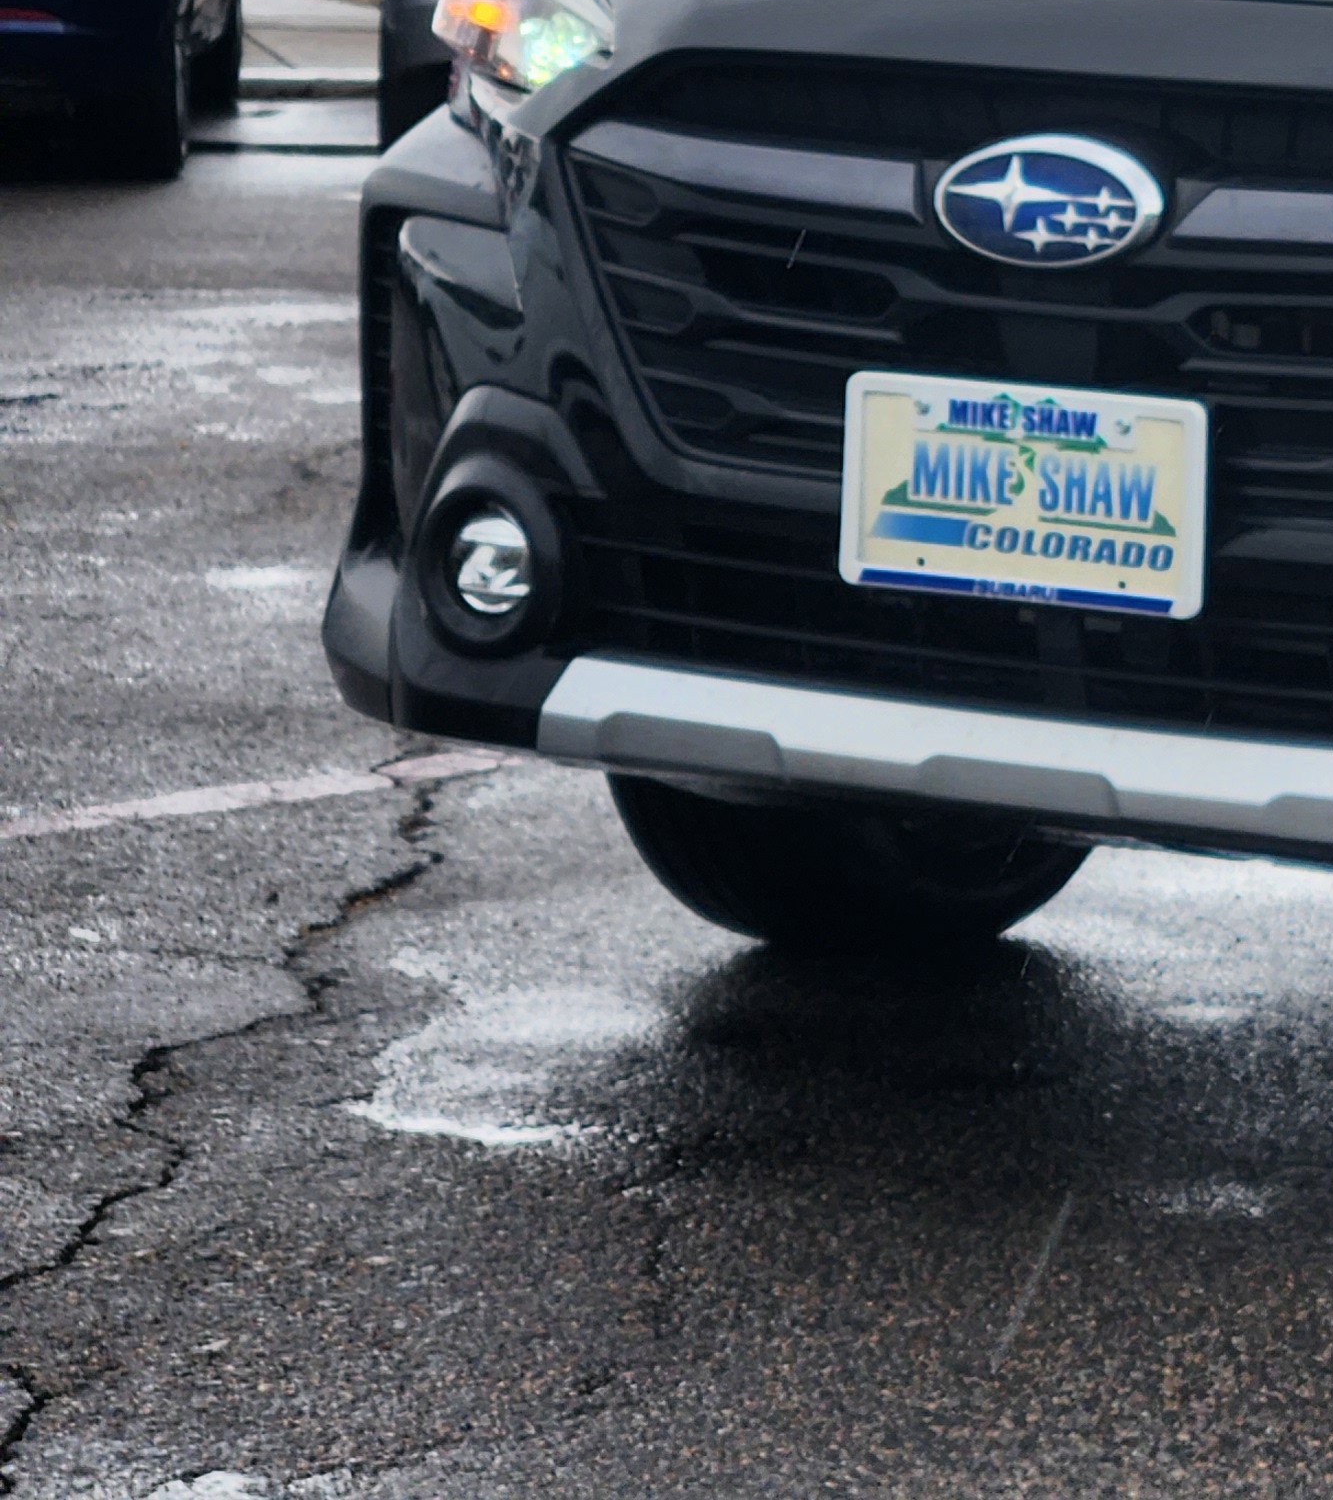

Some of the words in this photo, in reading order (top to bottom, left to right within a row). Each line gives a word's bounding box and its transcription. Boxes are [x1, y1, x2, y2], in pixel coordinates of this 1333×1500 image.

[948, 398, 1012, 431] MIKE
[1022, 406, 1097, 439] SHAW
[912, 441, 1015, 505] MIKE
[1037, 454, 1155, 523] SHAW
[966, 522, 1174, 572] COLORADO
[973, 579, 1058, 602] SUBARU
